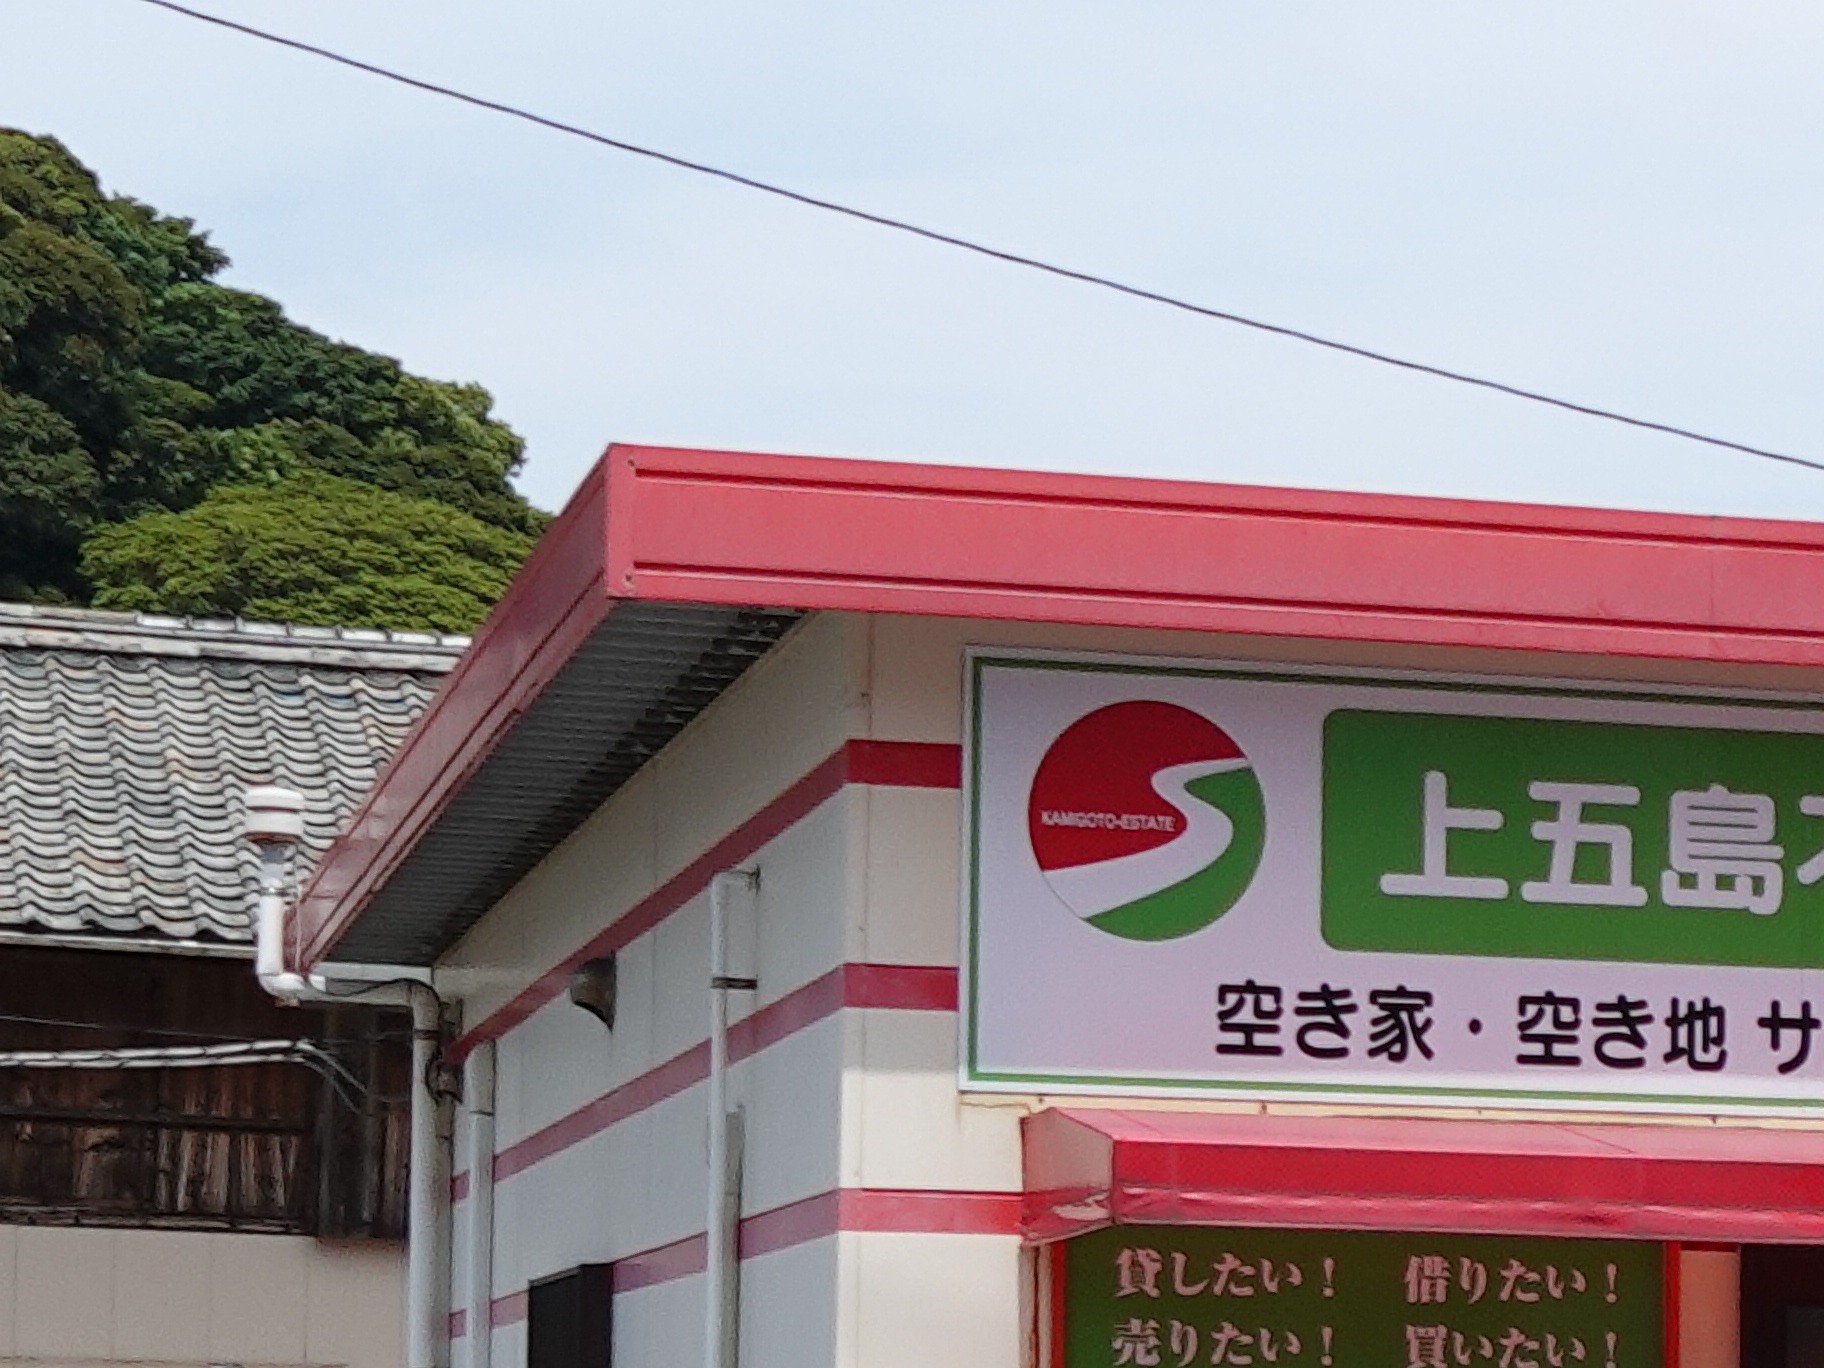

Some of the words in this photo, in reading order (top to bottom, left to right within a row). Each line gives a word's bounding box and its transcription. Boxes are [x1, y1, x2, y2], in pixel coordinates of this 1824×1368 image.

[1115, 1248, 1334, 1298] 貸したい！
[1404, 1255, 1617, 1304] 借りたい！
[1111, 1317, 1333, 1367] 売りたい！
